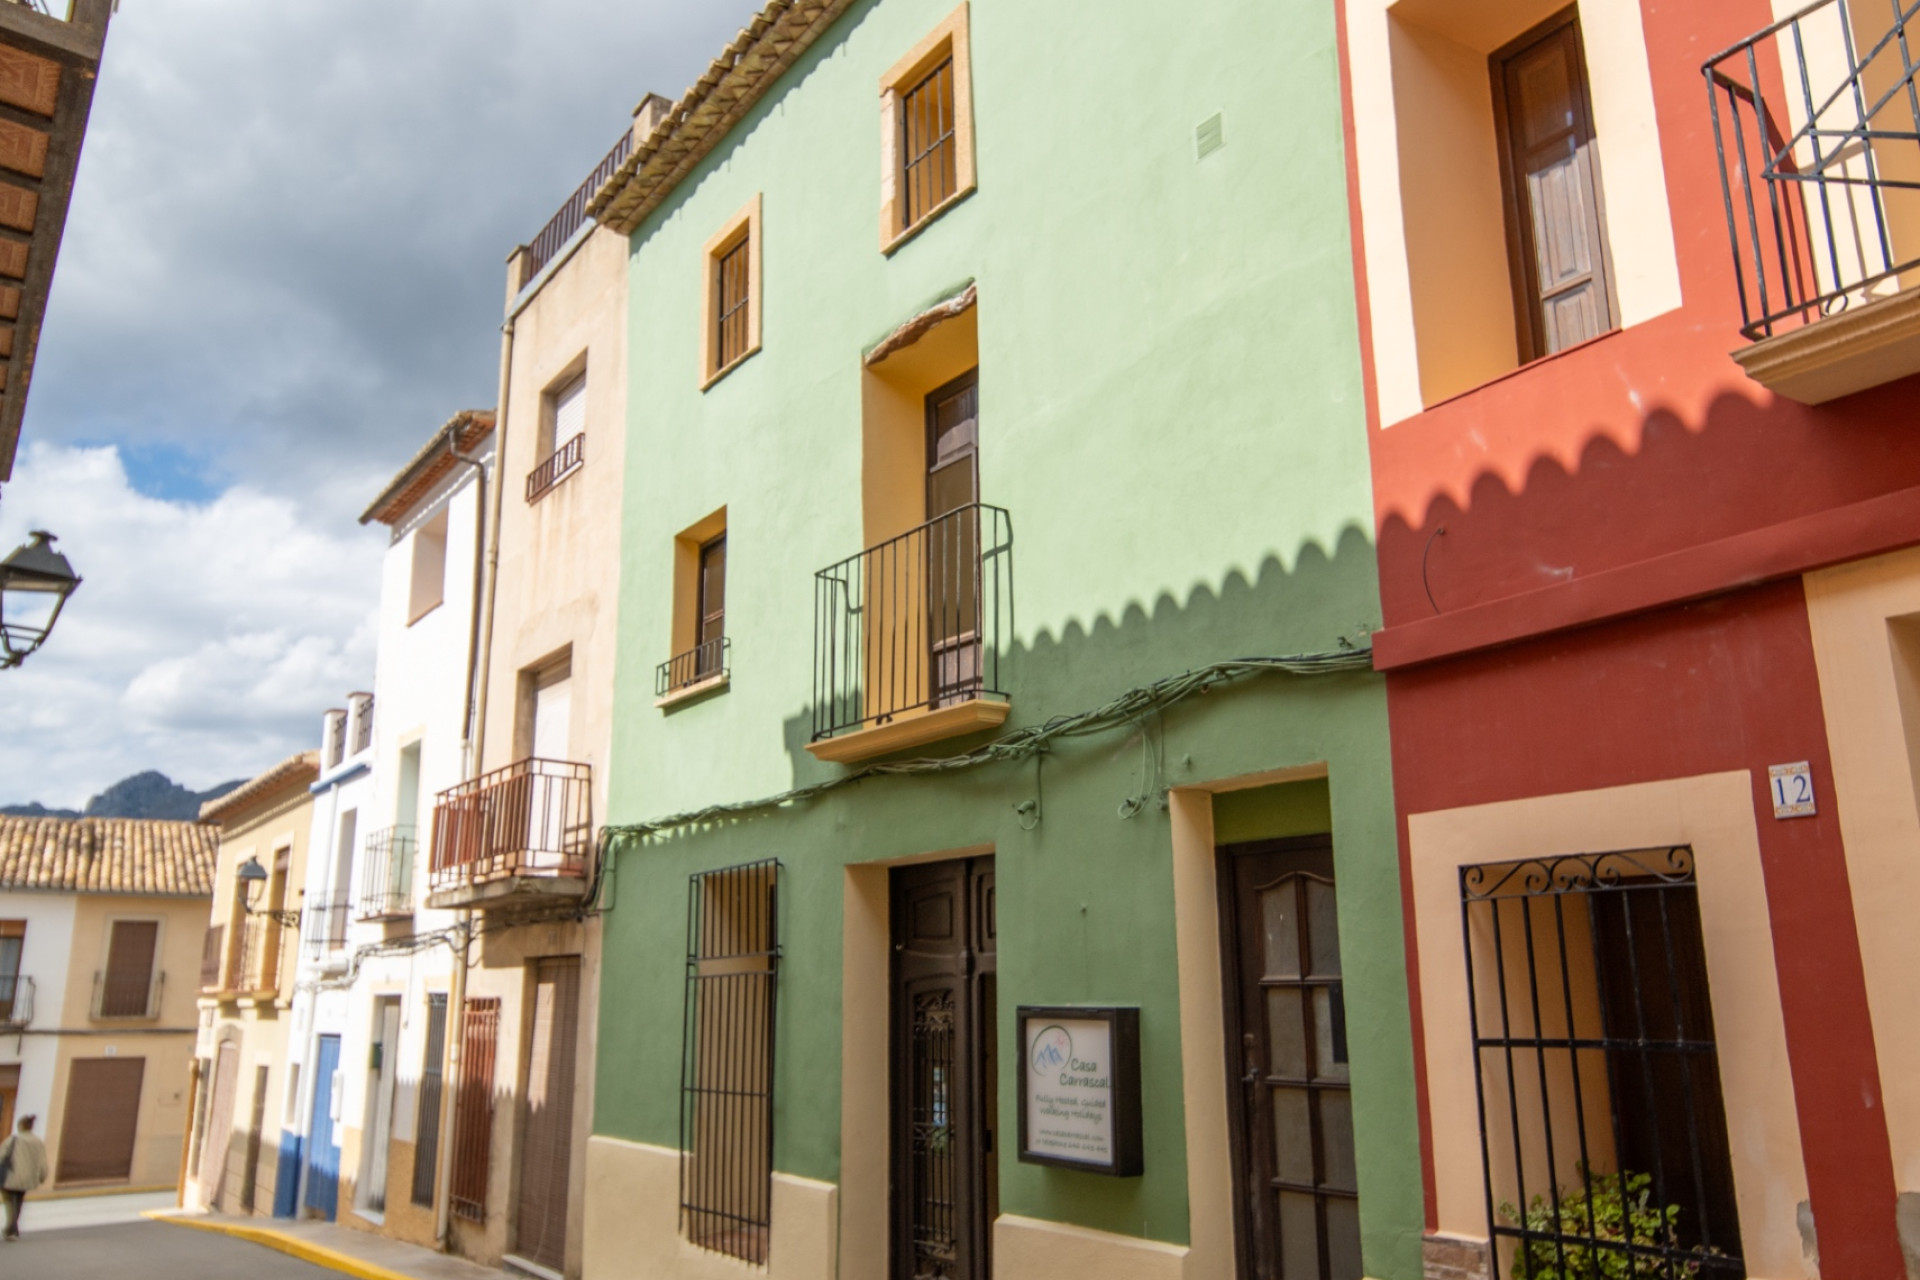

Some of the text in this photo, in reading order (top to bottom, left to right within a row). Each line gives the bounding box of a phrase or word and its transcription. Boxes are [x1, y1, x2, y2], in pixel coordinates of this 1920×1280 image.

[1775, 774, 1811, 805] 12
[1070, 1058, 1097, 1073] Casa
[1059, 1073, 1110, 1089] Carrascal
[1040, 1107, 1070, 1120] Walking
